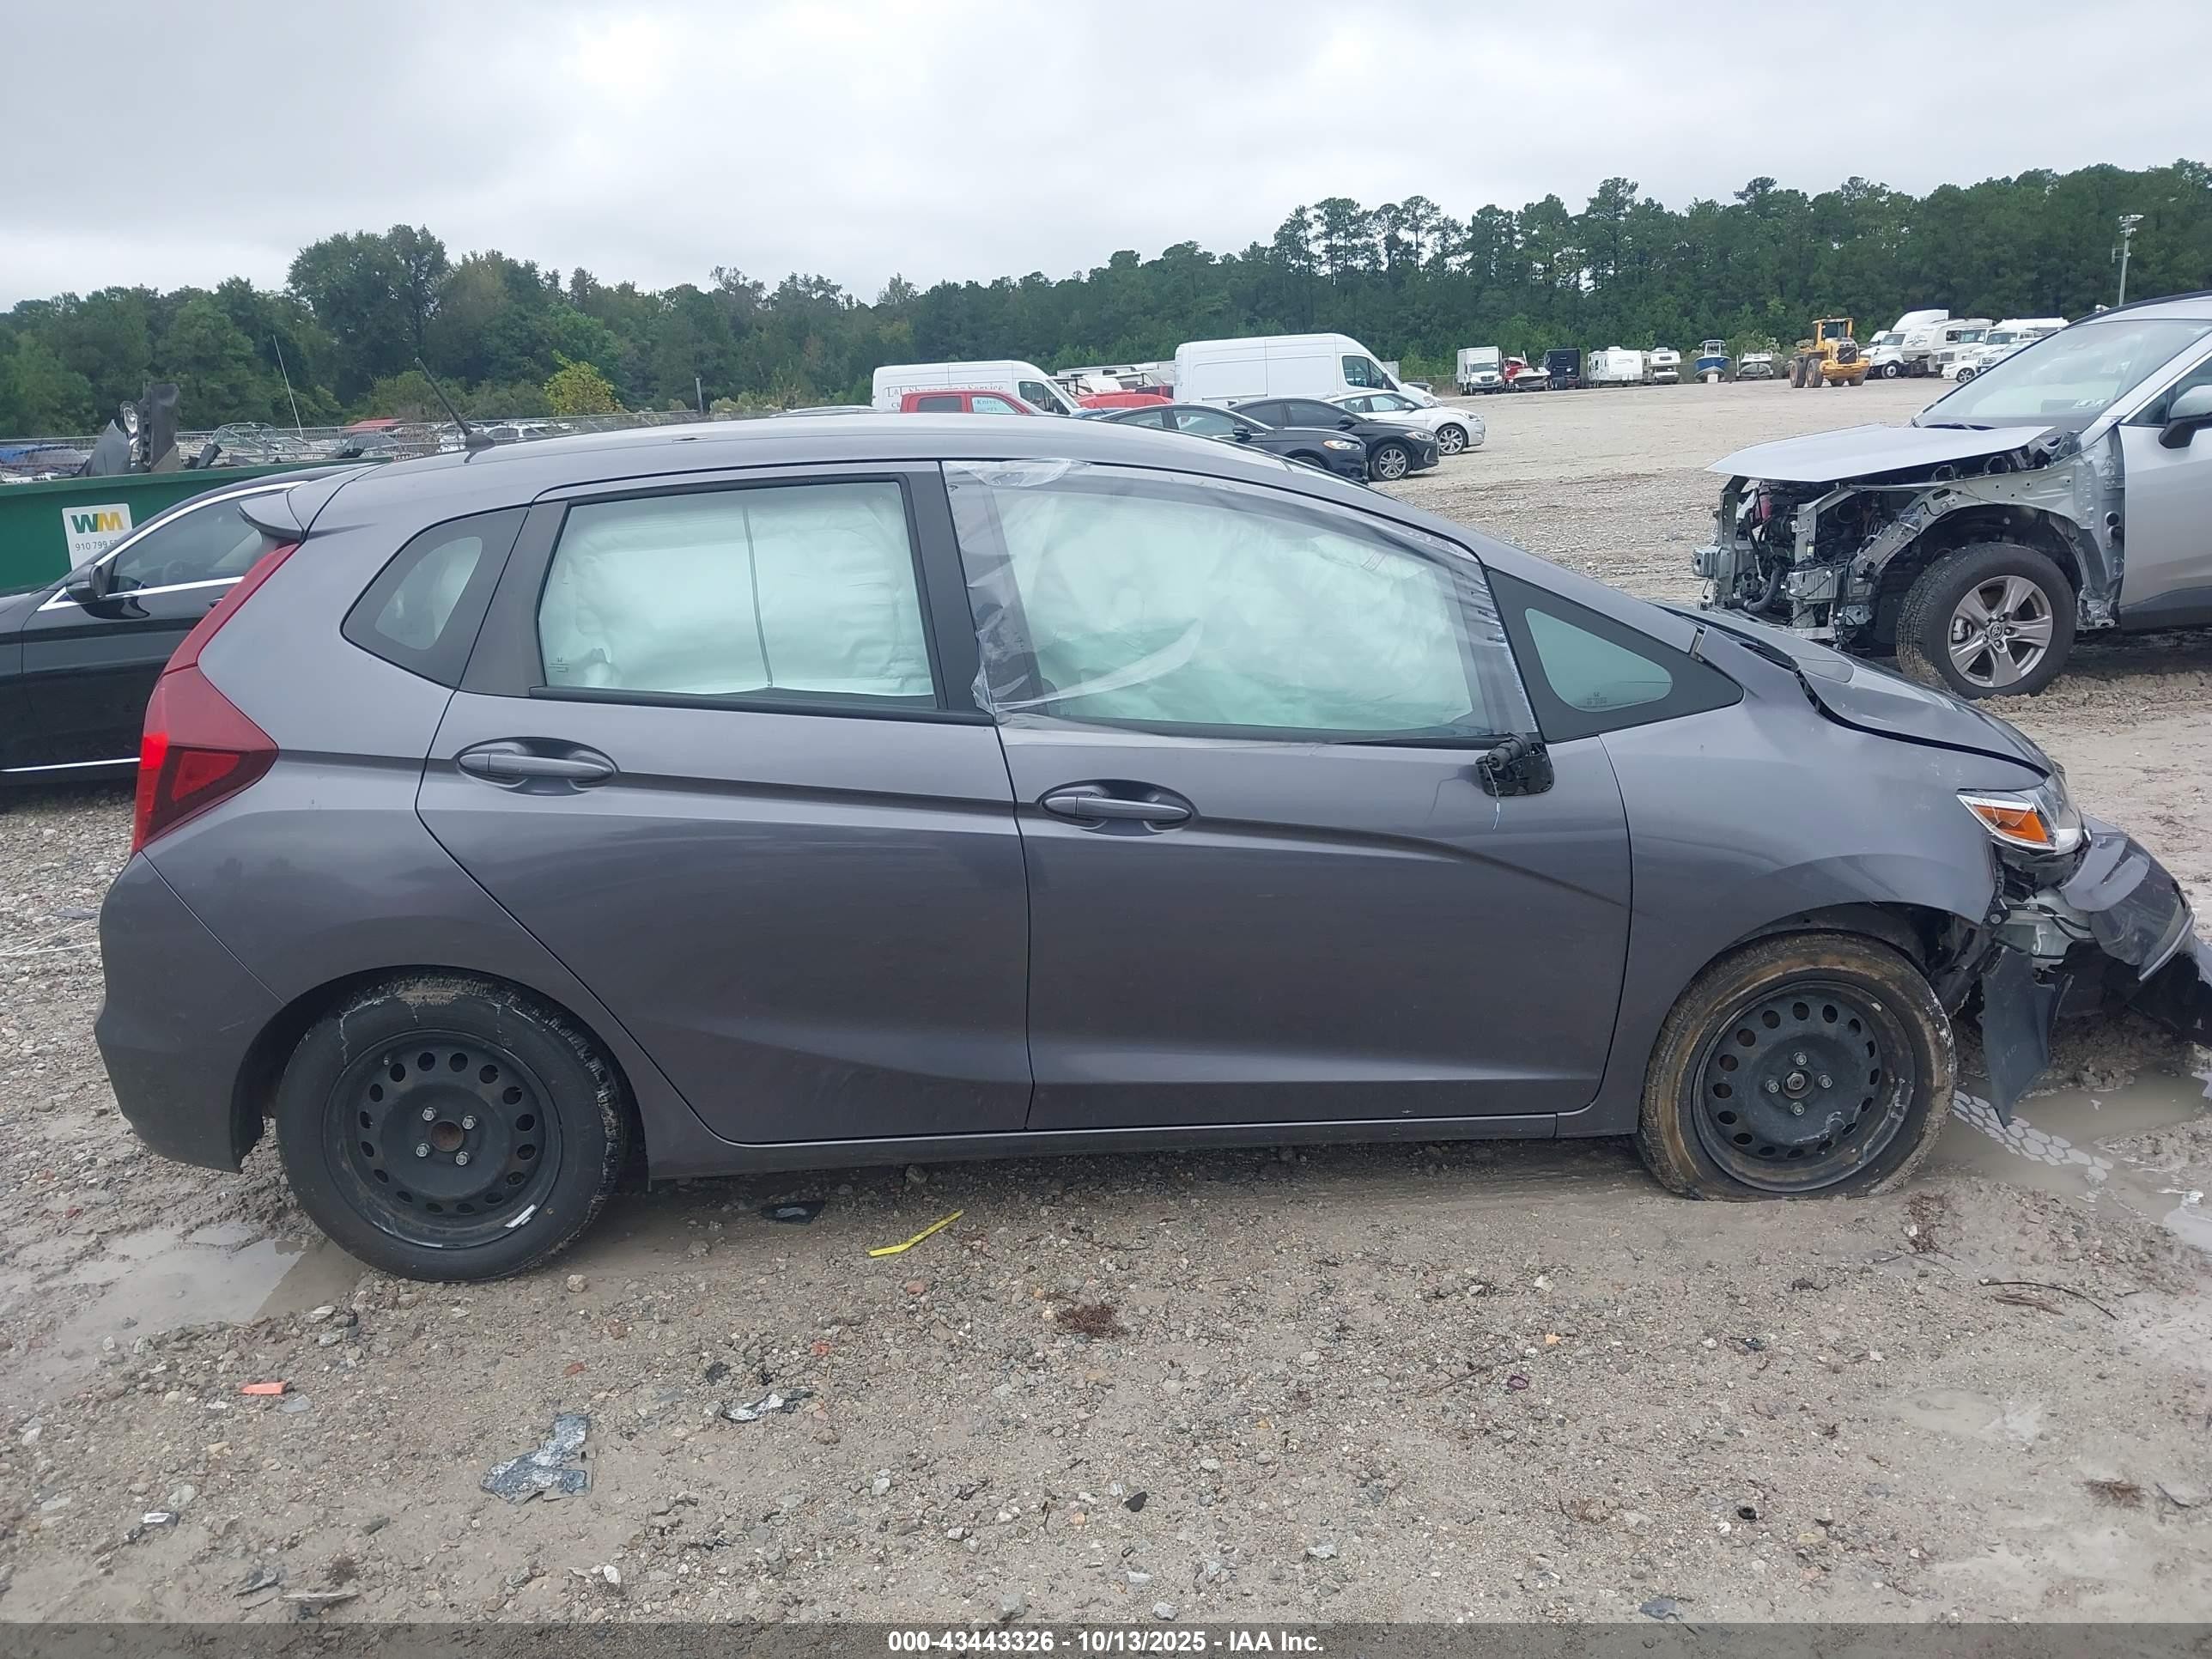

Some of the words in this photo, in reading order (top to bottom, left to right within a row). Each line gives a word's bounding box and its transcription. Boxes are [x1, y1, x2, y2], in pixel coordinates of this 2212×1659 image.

[70, 512, 125, 533] WM
[75, 542, 91, 551] 910
[92, 540, 108, 550] 799
